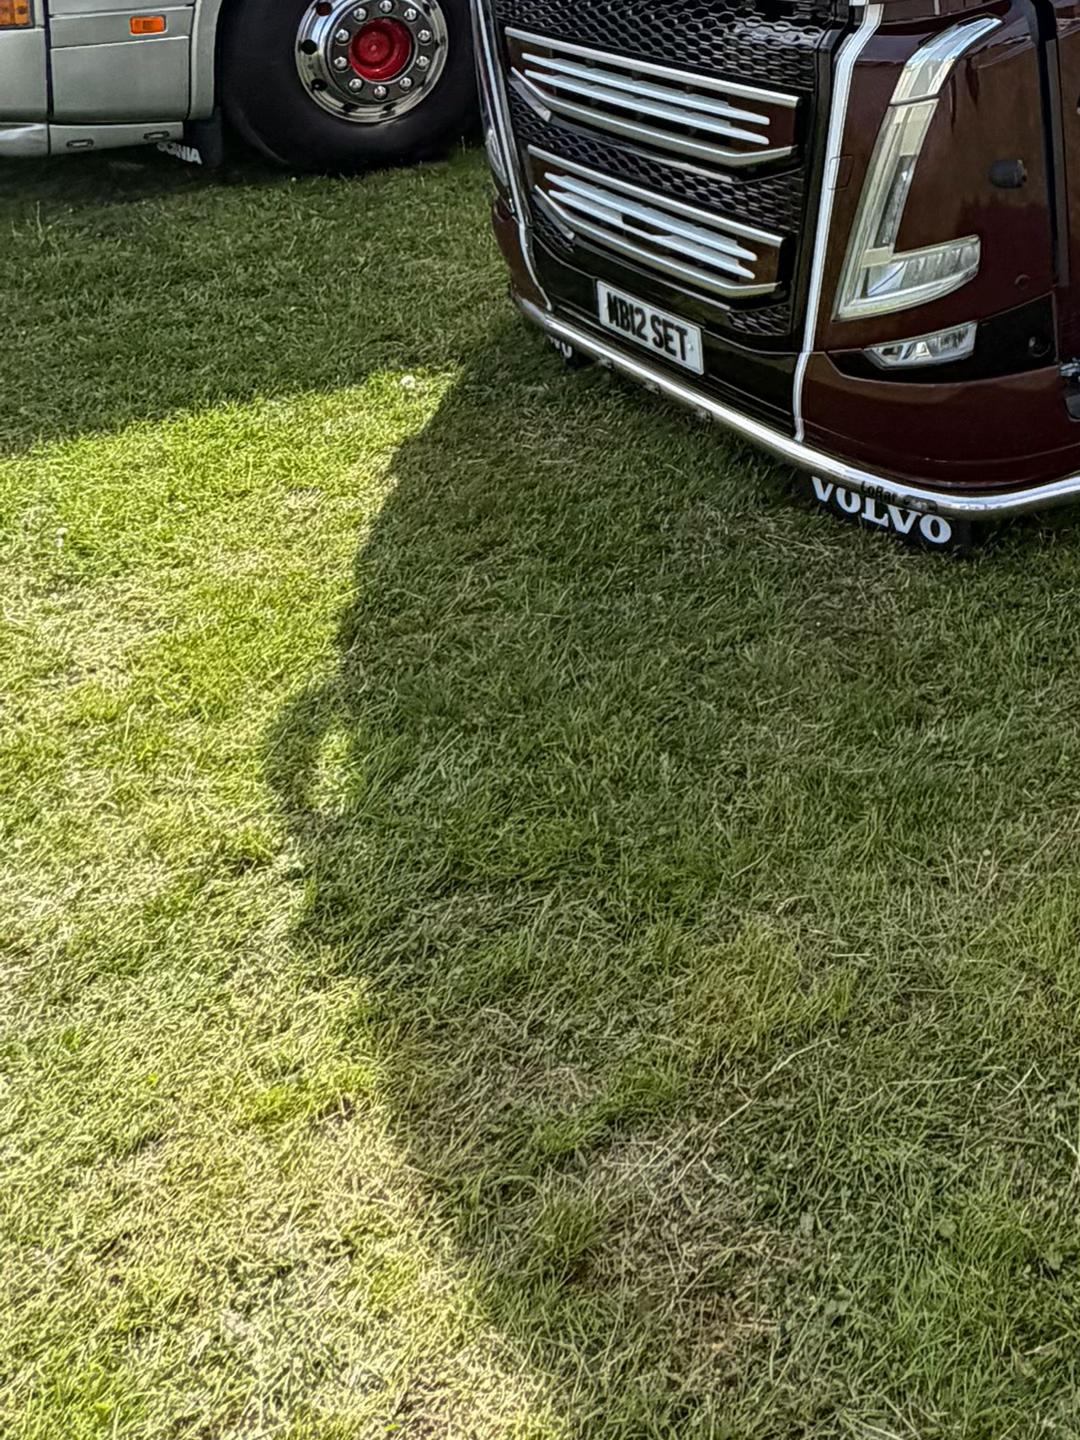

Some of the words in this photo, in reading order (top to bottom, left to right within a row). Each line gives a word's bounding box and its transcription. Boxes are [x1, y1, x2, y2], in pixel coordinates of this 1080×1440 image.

[606, 290, 649, 343] MB12
[649, 313, 688, 362] SET
[811, 475, 952, 545] VOLVO
